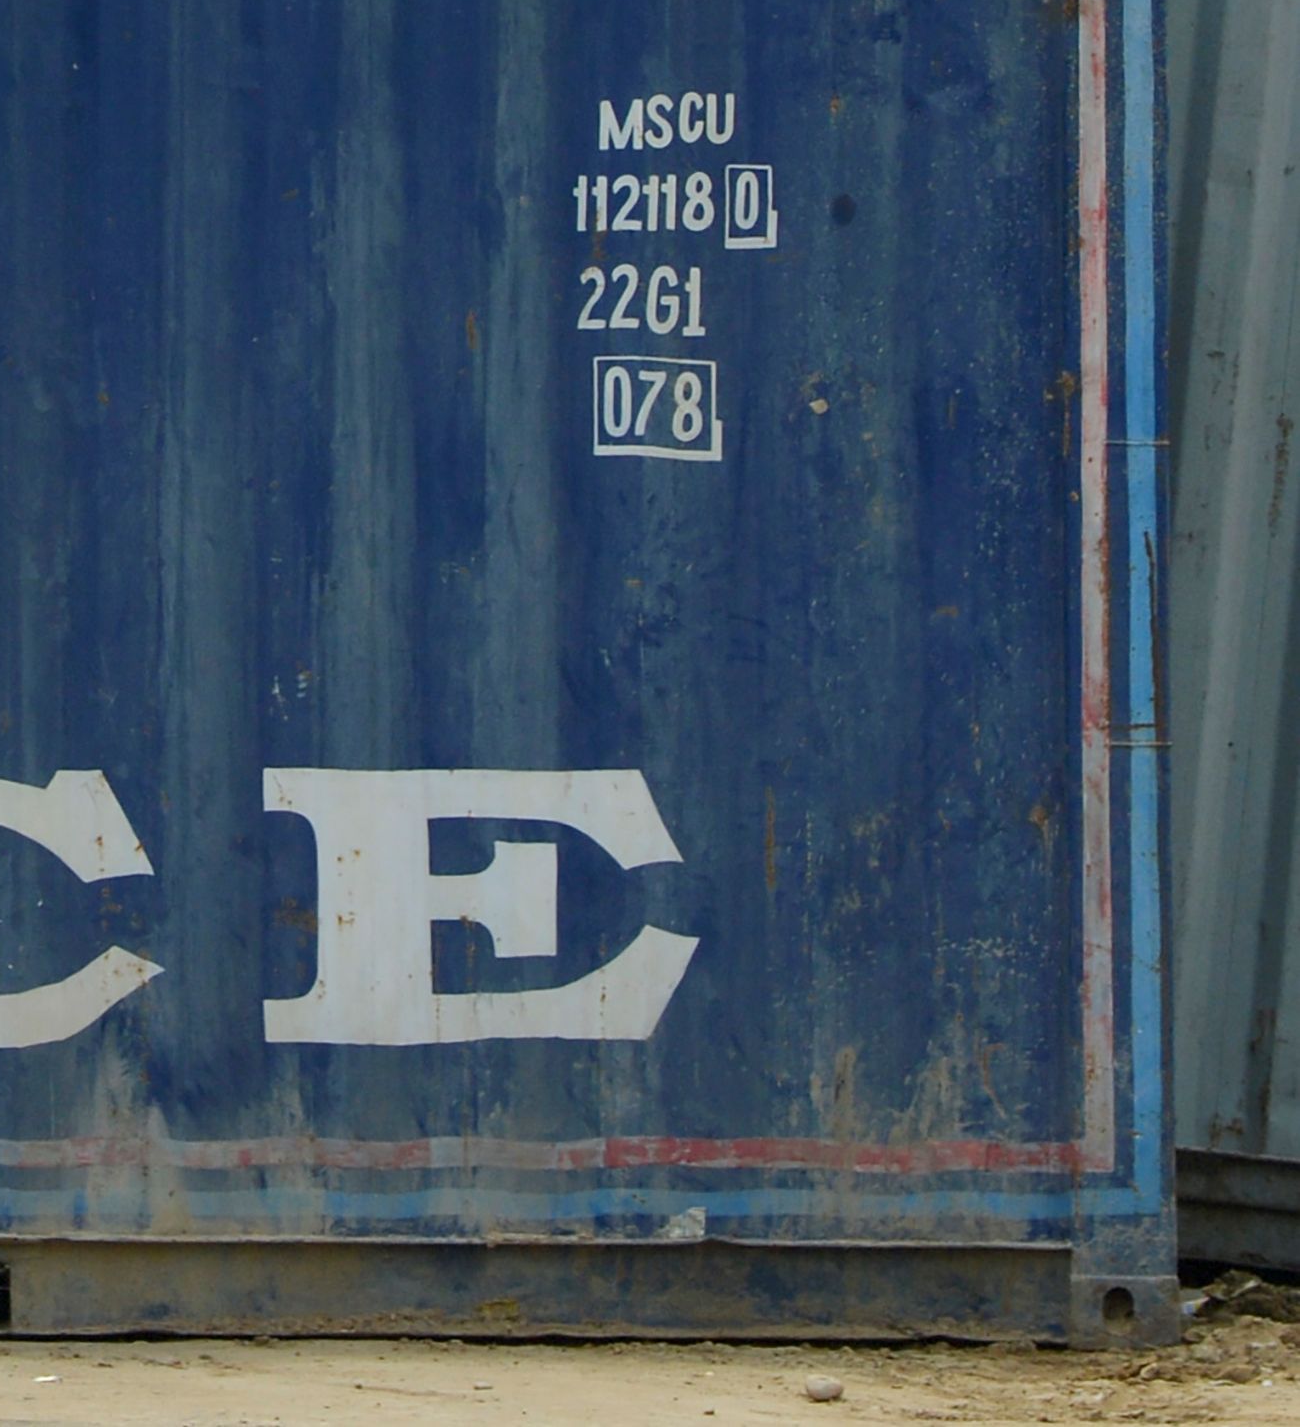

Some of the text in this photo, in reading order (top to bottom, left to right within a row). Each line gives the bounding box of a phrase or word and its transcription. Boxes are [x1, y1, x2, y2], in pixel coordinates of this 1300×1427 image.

[599, 91, 736, 151] MSCU
[573, 171, 716, 232] 112118
[577, 263, 706, 337] 22G1
[603, 366, 703, 442] 078
